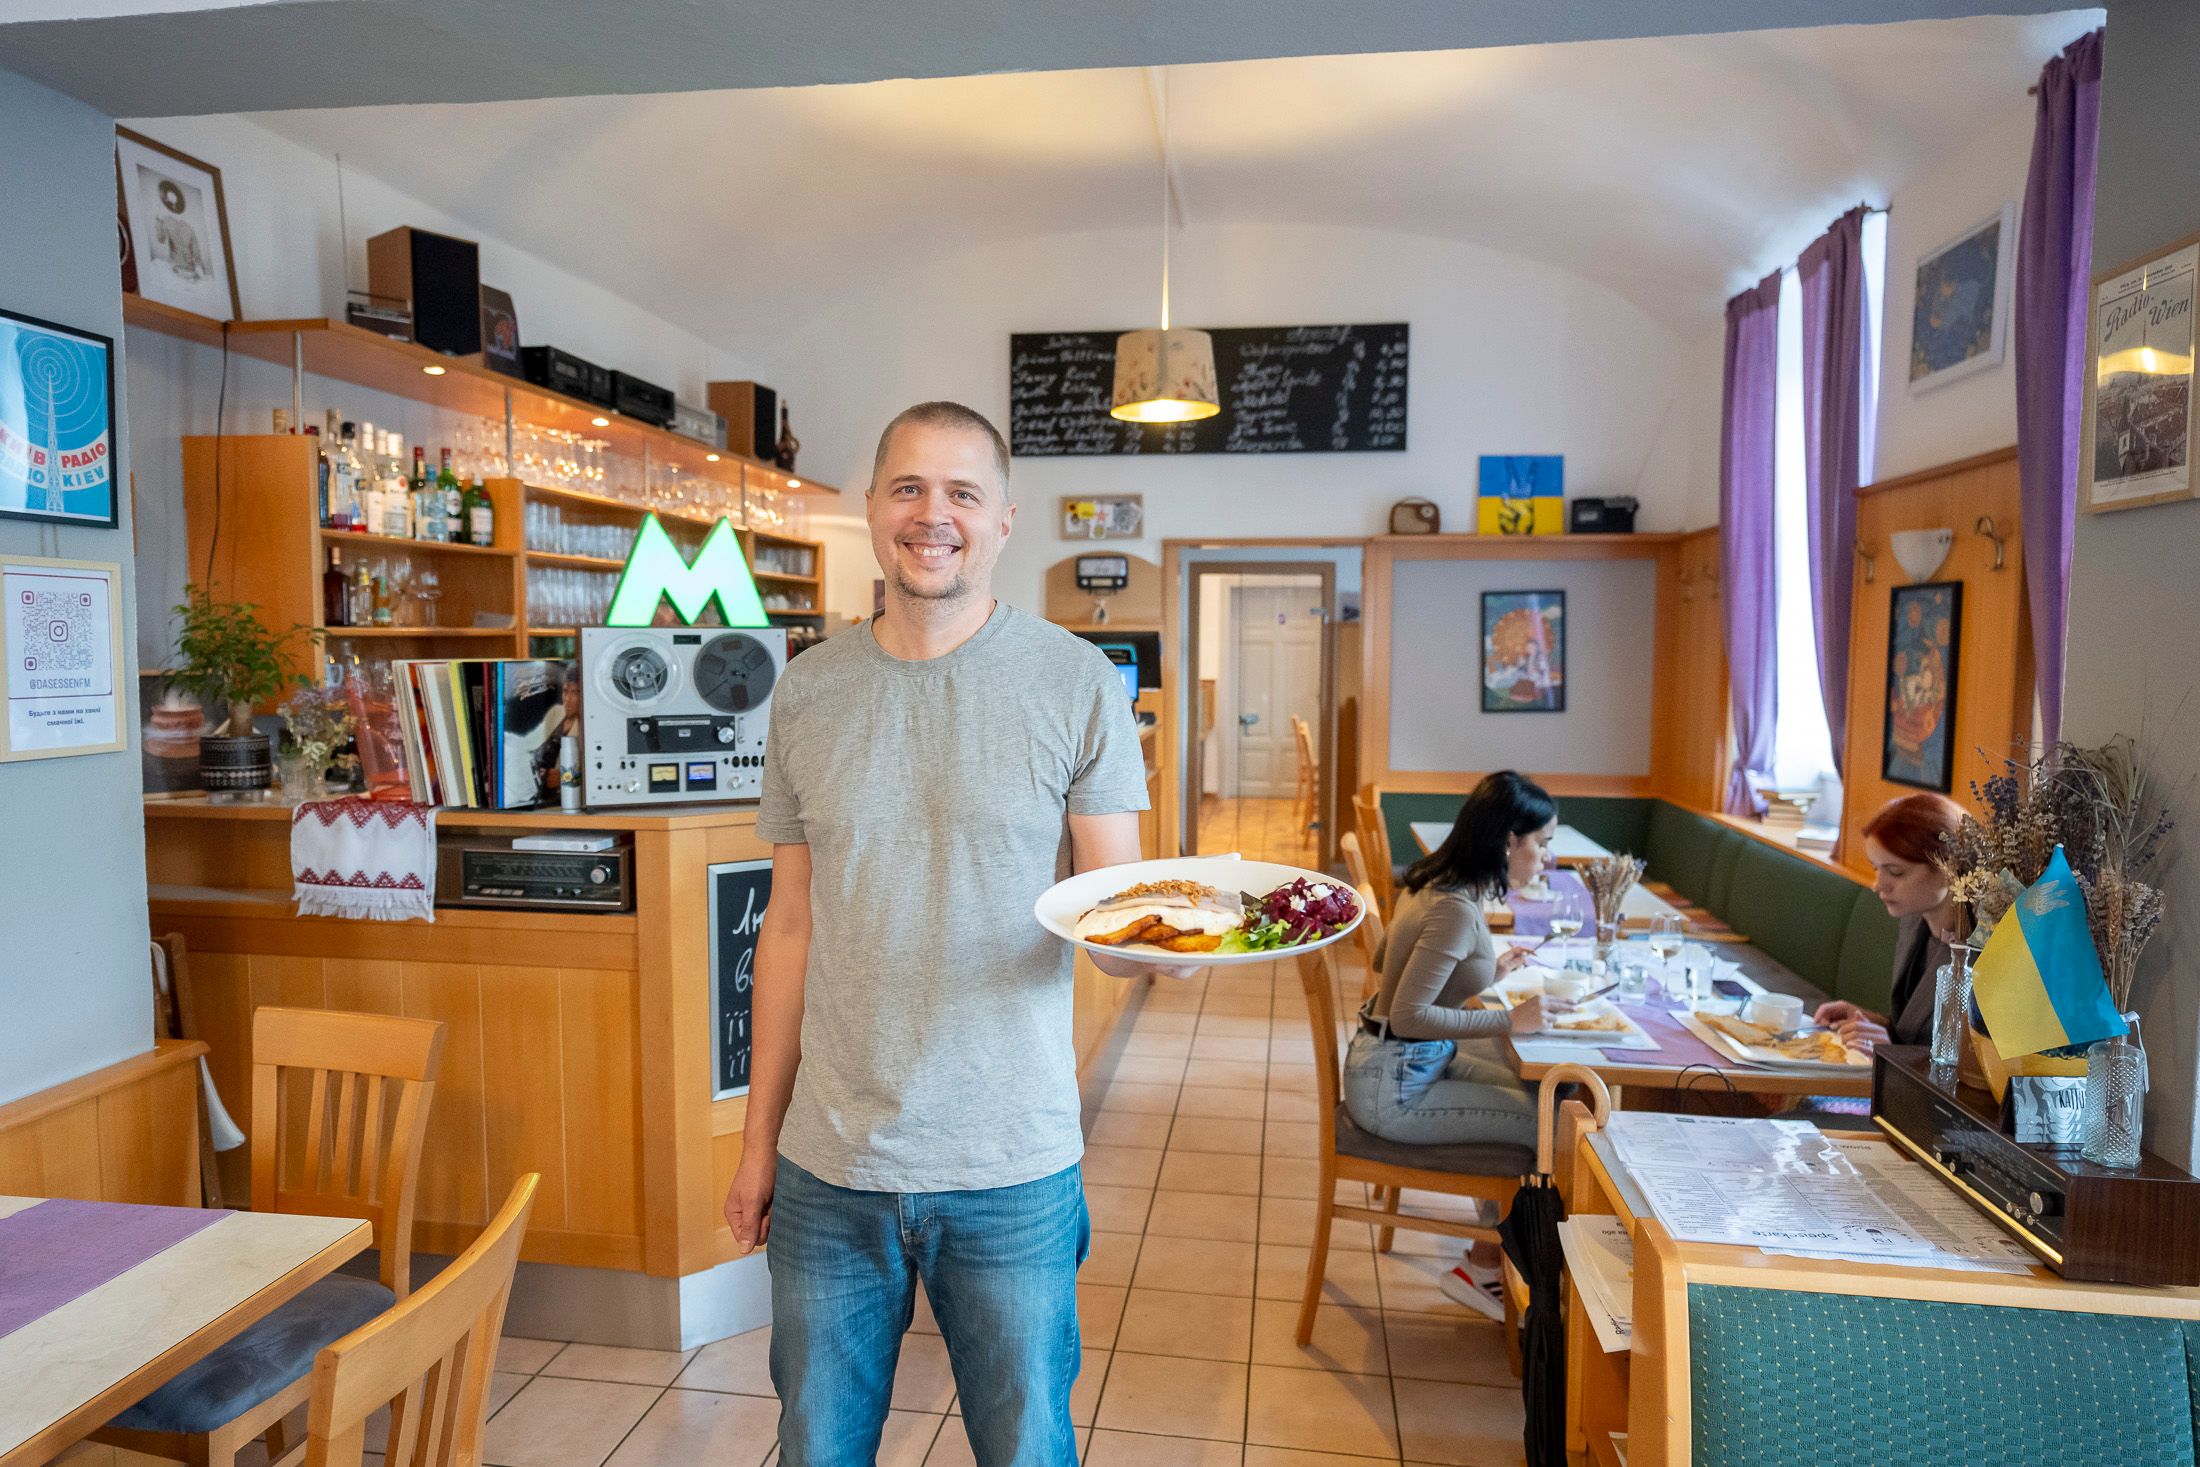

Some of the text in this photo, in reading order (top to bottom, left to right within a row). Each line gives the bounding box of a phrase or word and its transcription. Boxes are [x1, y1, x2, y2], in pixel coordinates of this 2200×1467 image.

[2148, 296, 2189, 327] Wien
[61, 442, 107, 468] РАДІО
[62, 465, 105, 487] KIEV
[606, 513, 771, 627] M
[29, 678, 91, 690] @DASESSENFM
[28, 709, 51, 718] Будьте
[46, 718, 73, 727] смачної
[2058, 1088, 2089, 1110] KATTU
